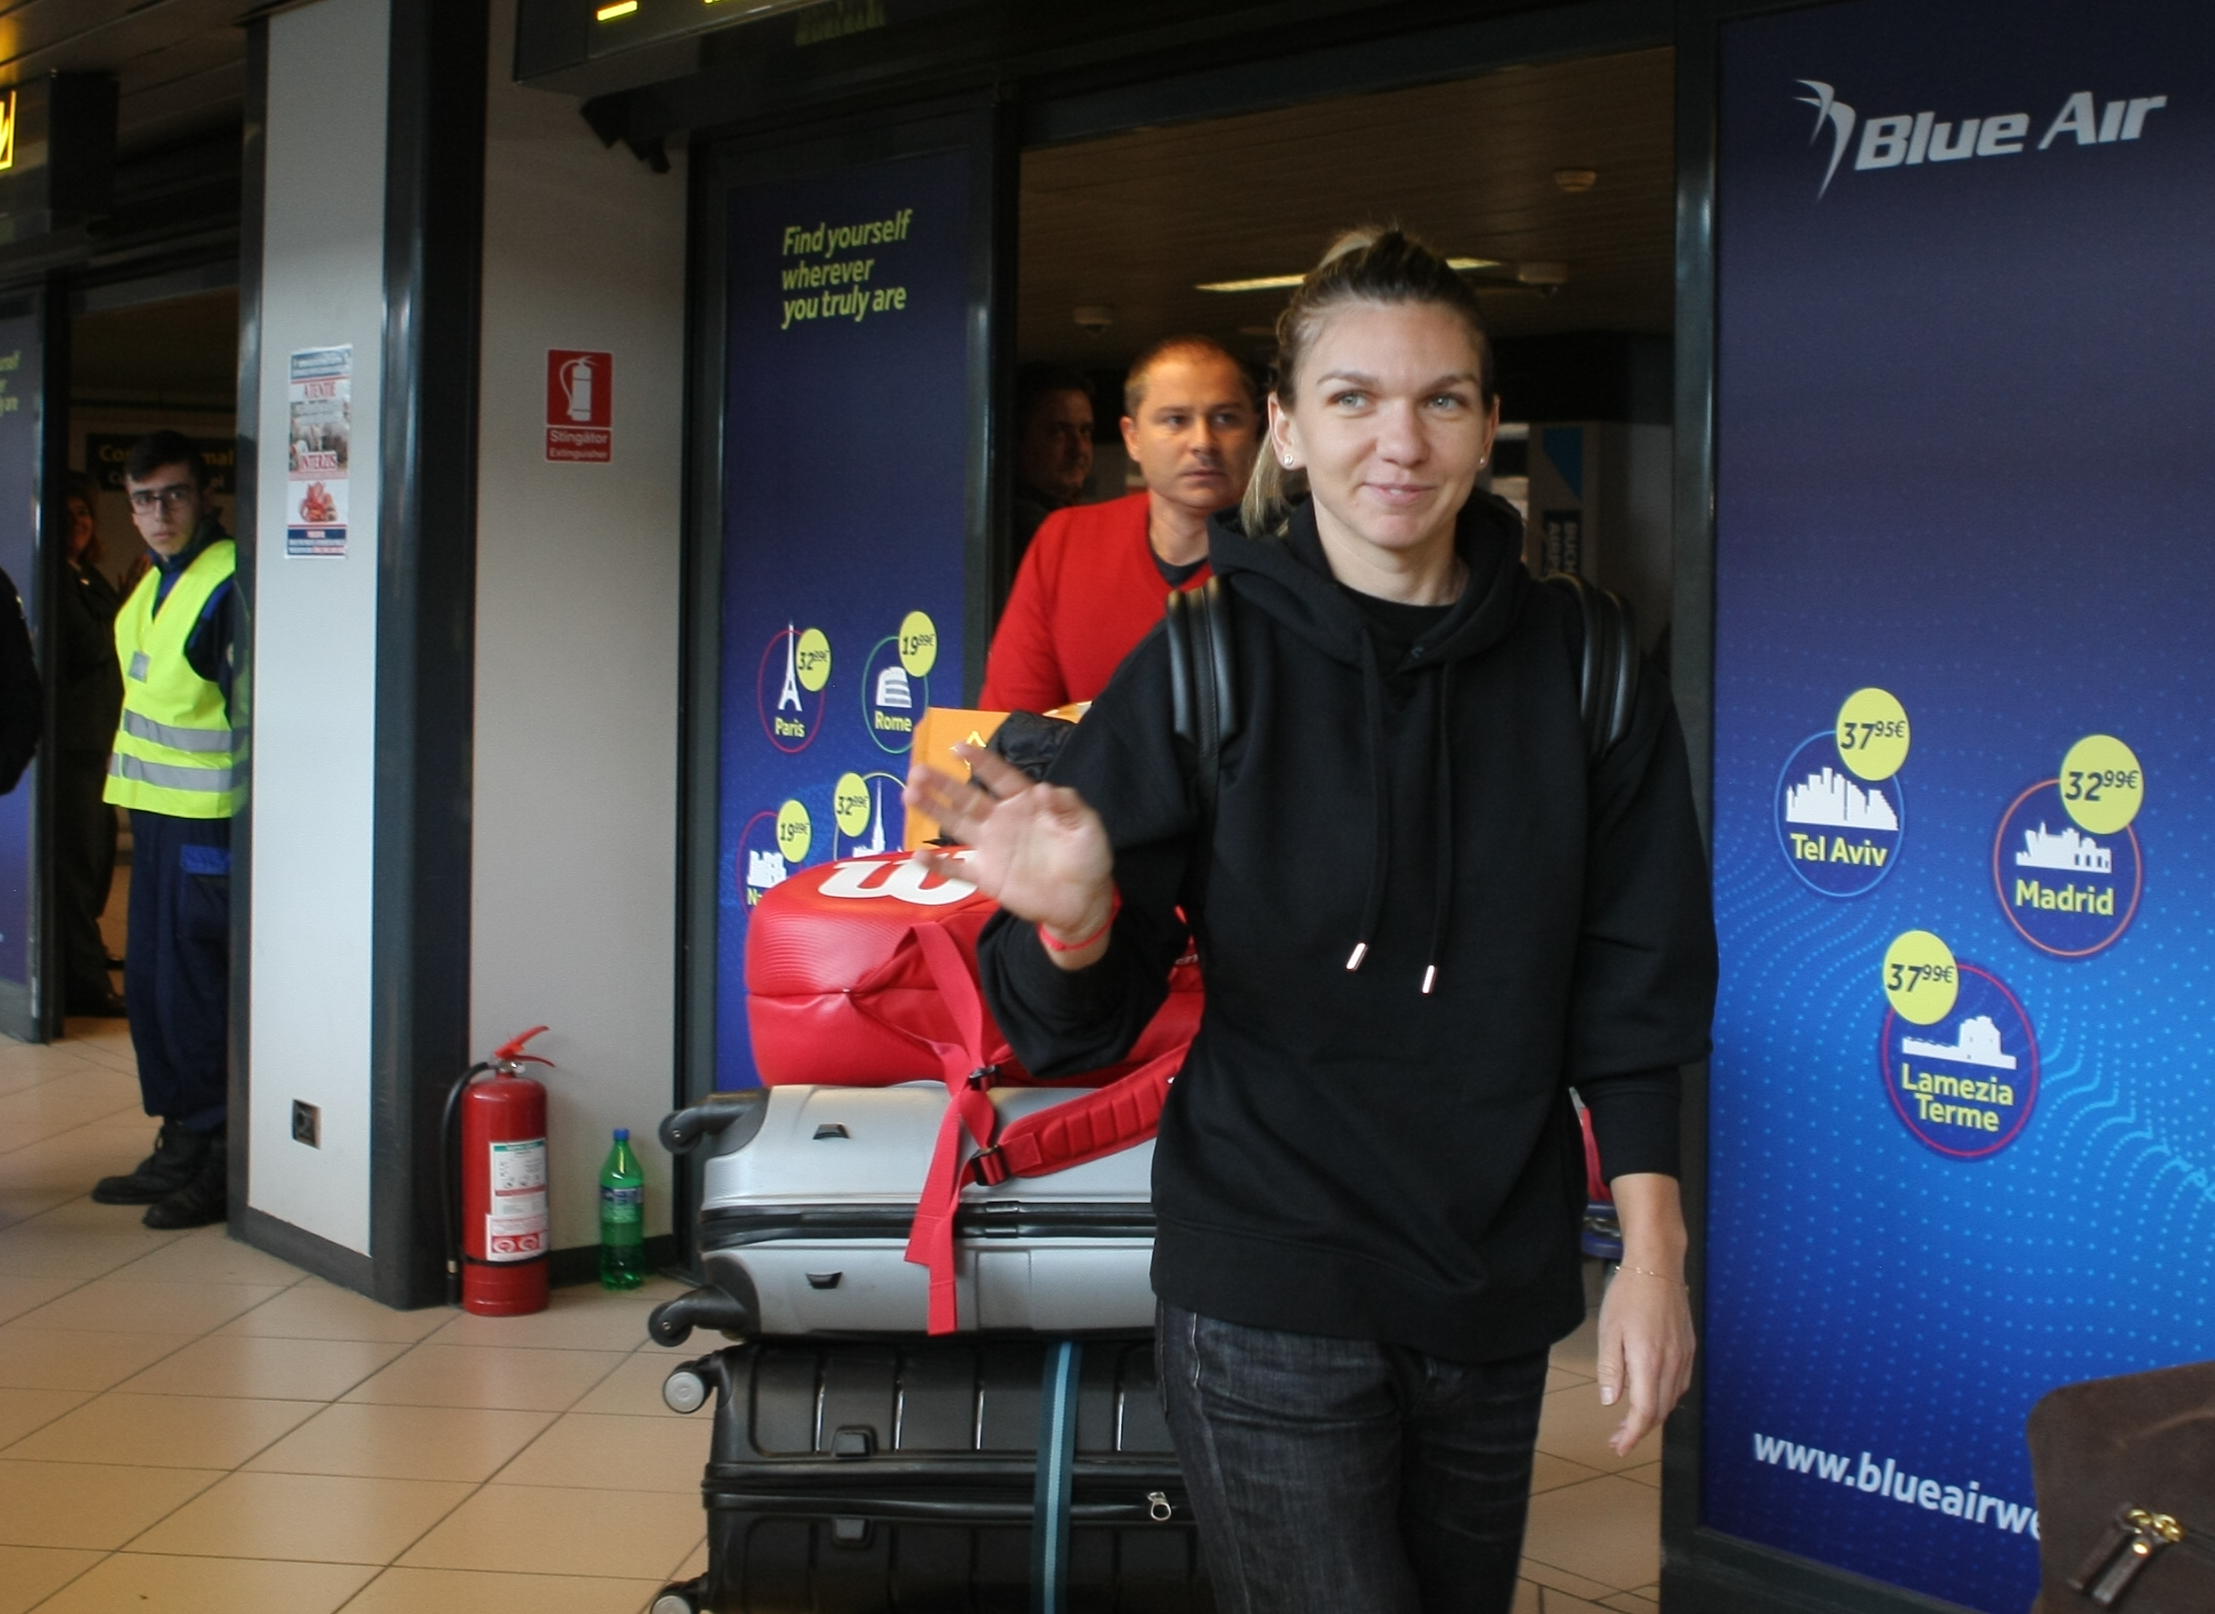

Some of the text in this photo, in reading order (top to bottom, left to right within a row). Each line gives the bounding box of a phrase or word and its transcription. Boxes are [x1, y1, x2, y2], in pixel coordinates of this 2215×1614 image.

[1855, 91, 2167, 170] Blue Air
[783, 209, 914, 258] Find yourself
[782, 258, 875, 290] wherever
[781, 286, 907, 330] you truly are
[775, 717, 806, 739] Paris
[874, 711, 914, 733] Rome
[1790, 833, 1888, 868] Tel Aviv
[2015, 880, 2115, 917] Madrid
[1901, 1064, 2014, 1107] Lamezia
[1916, 1096, 1999, 1132] Terme
